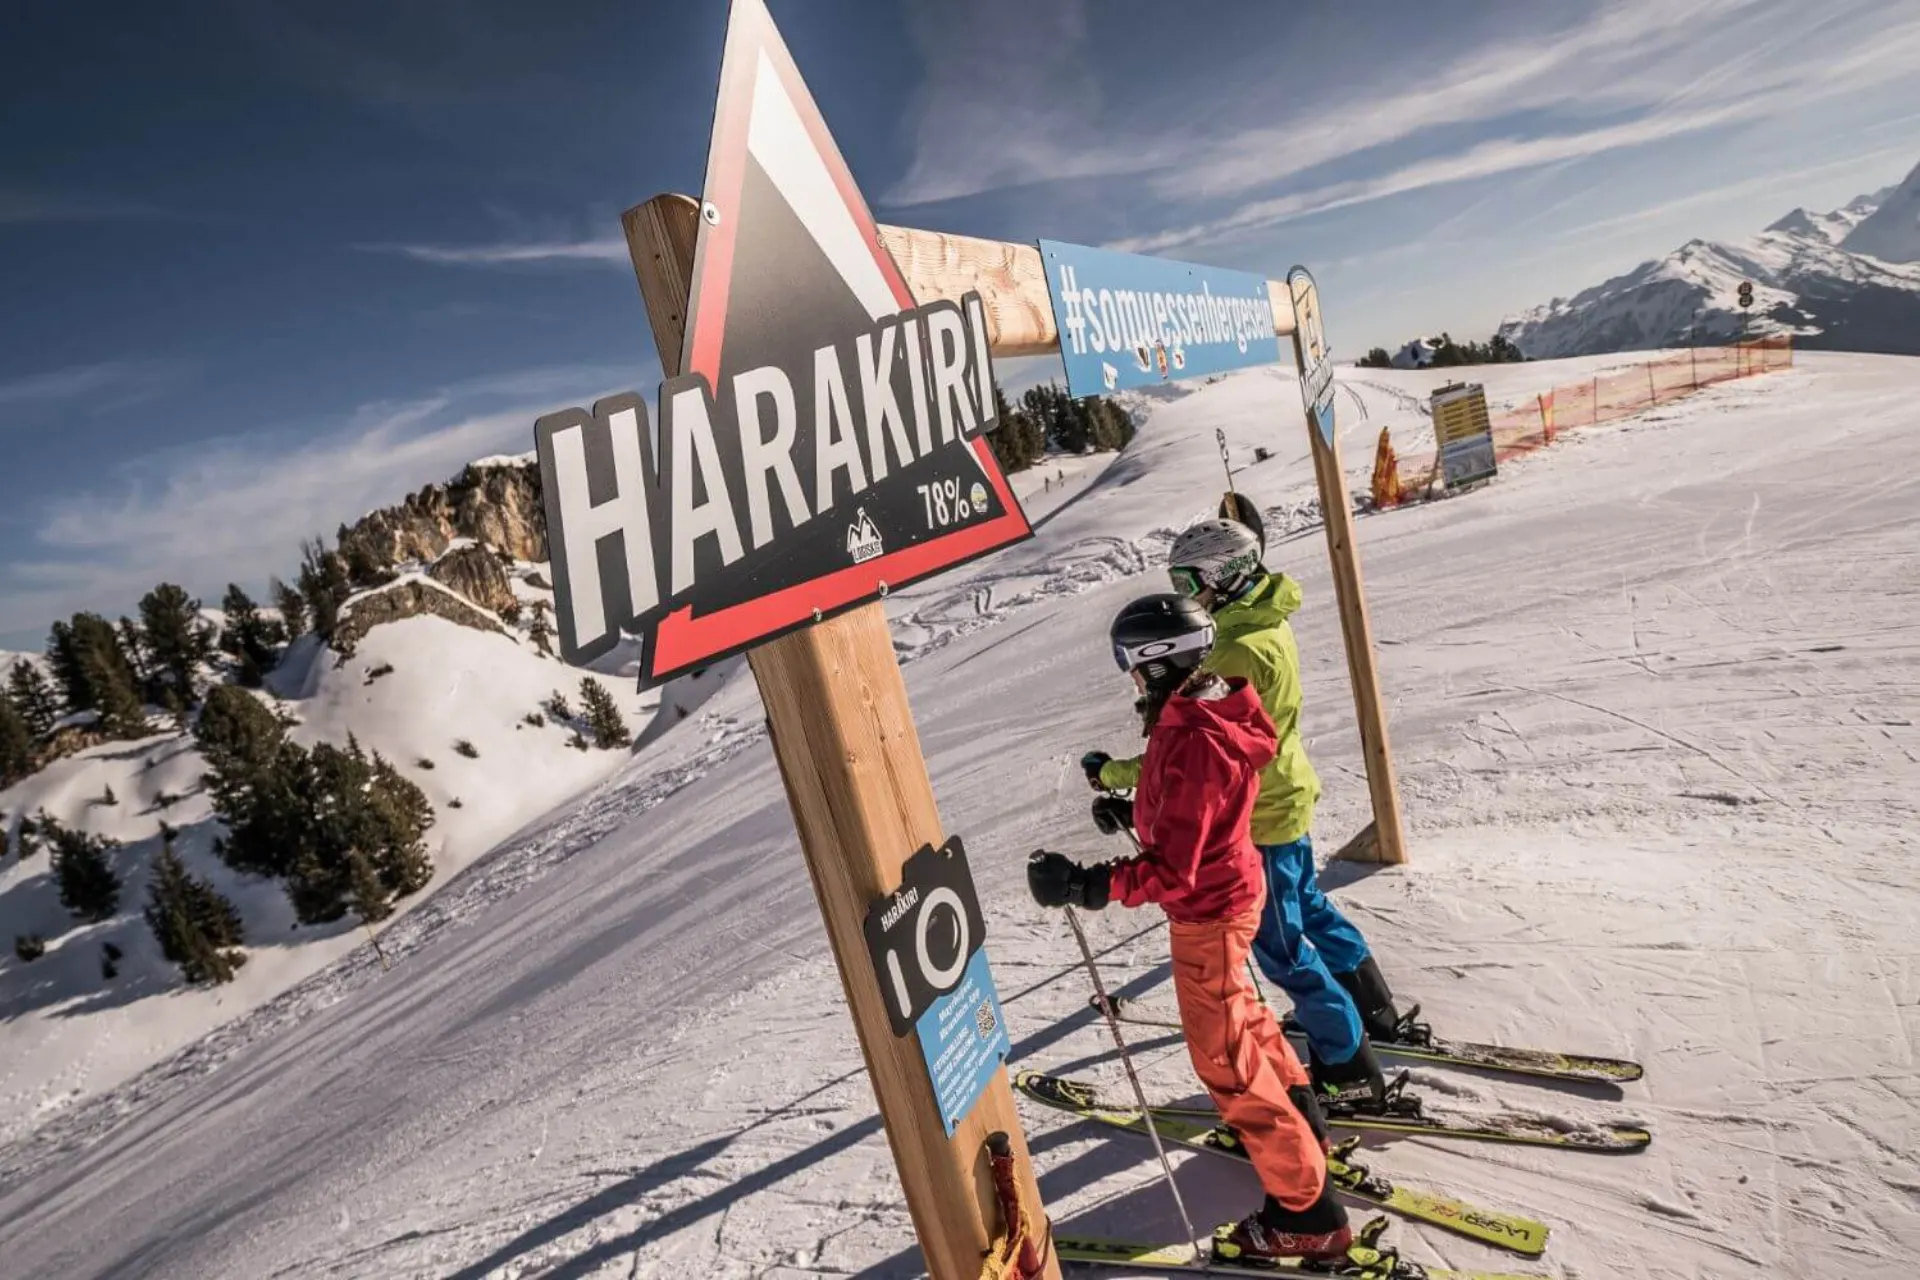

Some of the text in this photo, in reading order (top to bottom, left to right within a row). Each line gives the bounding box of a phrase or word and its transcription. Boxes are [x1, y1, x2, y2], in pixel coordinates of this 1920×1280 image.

[552, 299, 995, 649] HARAKIRI
[916, 476, 970, 530] 78%
[880, 886, 919, 933] HARAKIRI
